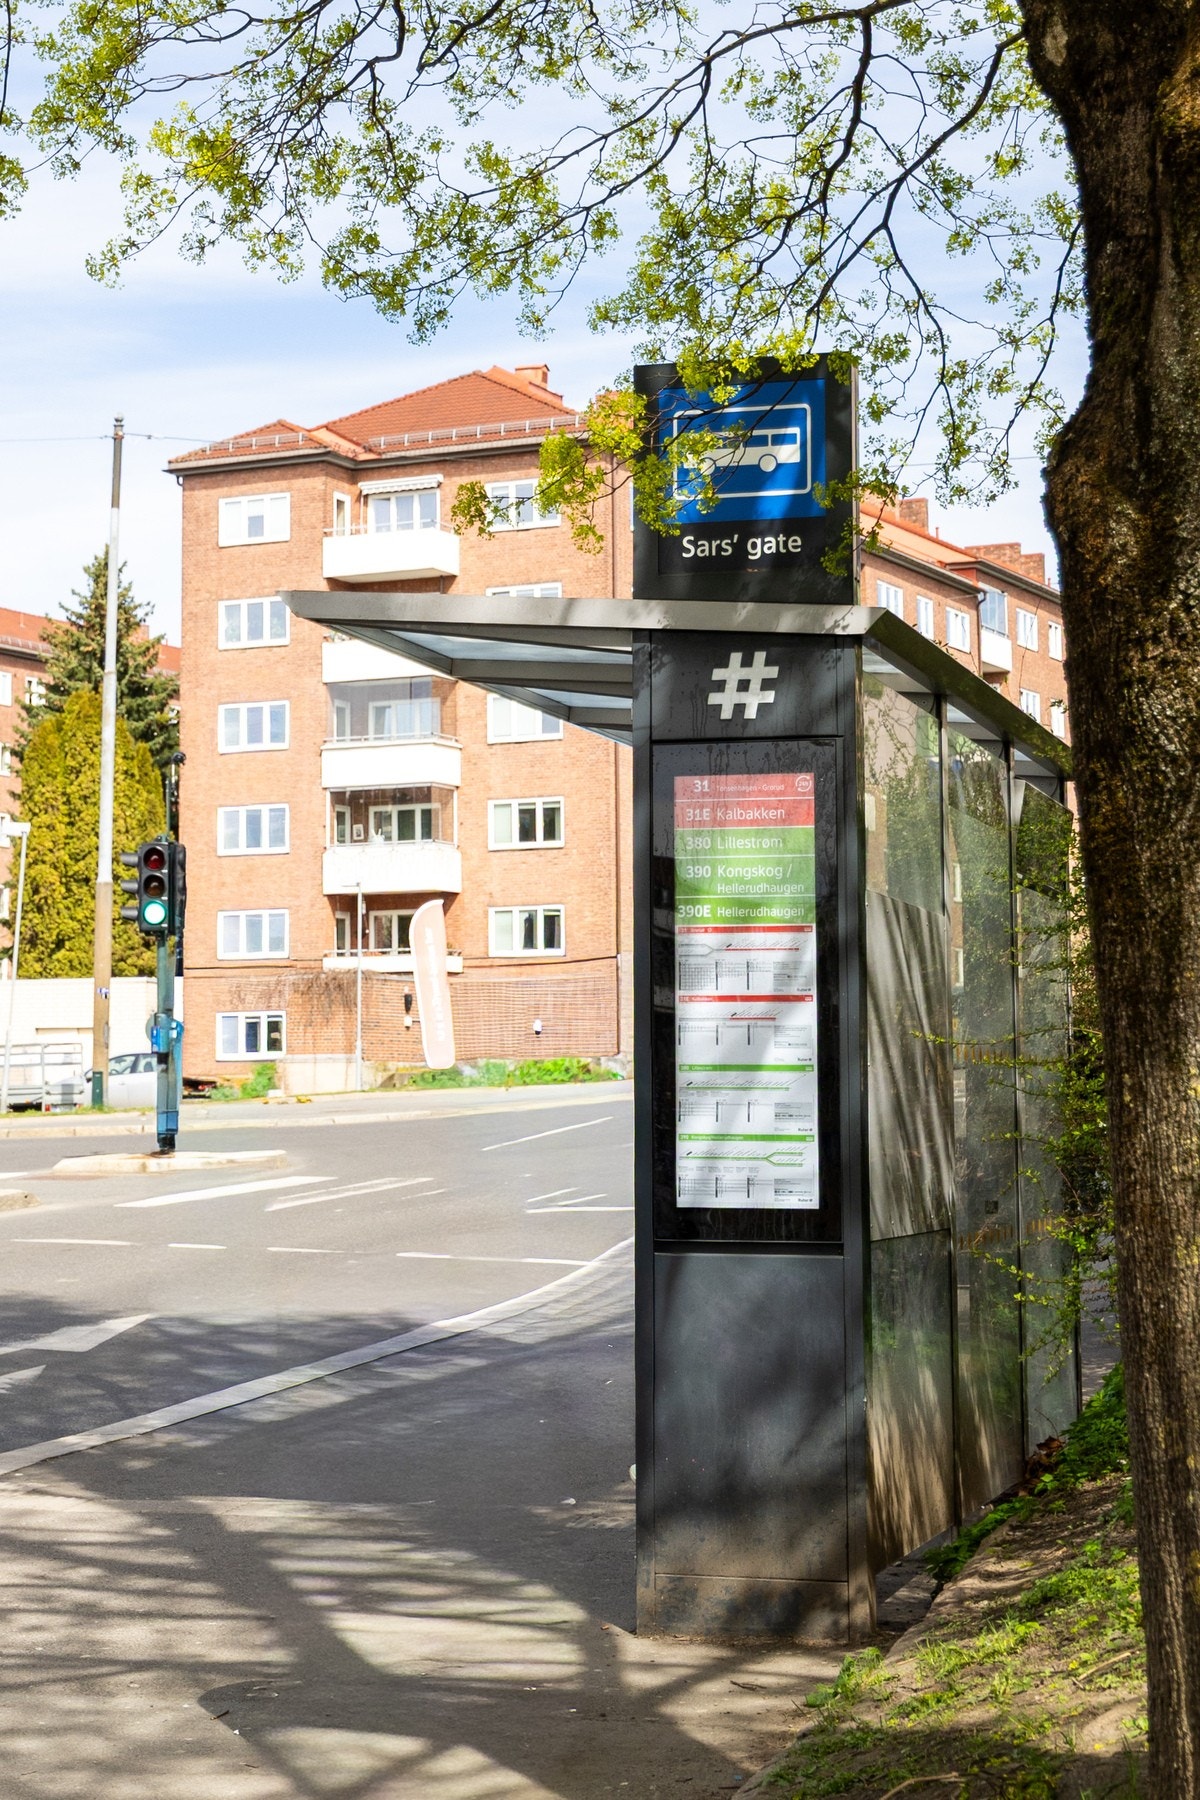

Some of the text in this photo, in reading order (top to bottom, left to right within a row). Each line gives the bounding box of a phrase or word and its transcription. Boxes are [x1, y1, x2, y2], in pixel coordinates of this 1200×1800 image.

[746, 533, 802, 560] gate
[693, 779, 710, 792] 31
[762, 783, 785, 792] Grorud
[686, 807, 785, 821] 31E Kalbakken
[686, 836, 783, 850] 380 Lillestrøm
[686, 865, 711, 878] 390
[717, 864, 783, 880] Kongskog
[717, 882, 805, 895] Hellerudhaugen
[677, 904, 805, 918] 390E Hellerudhaugen
